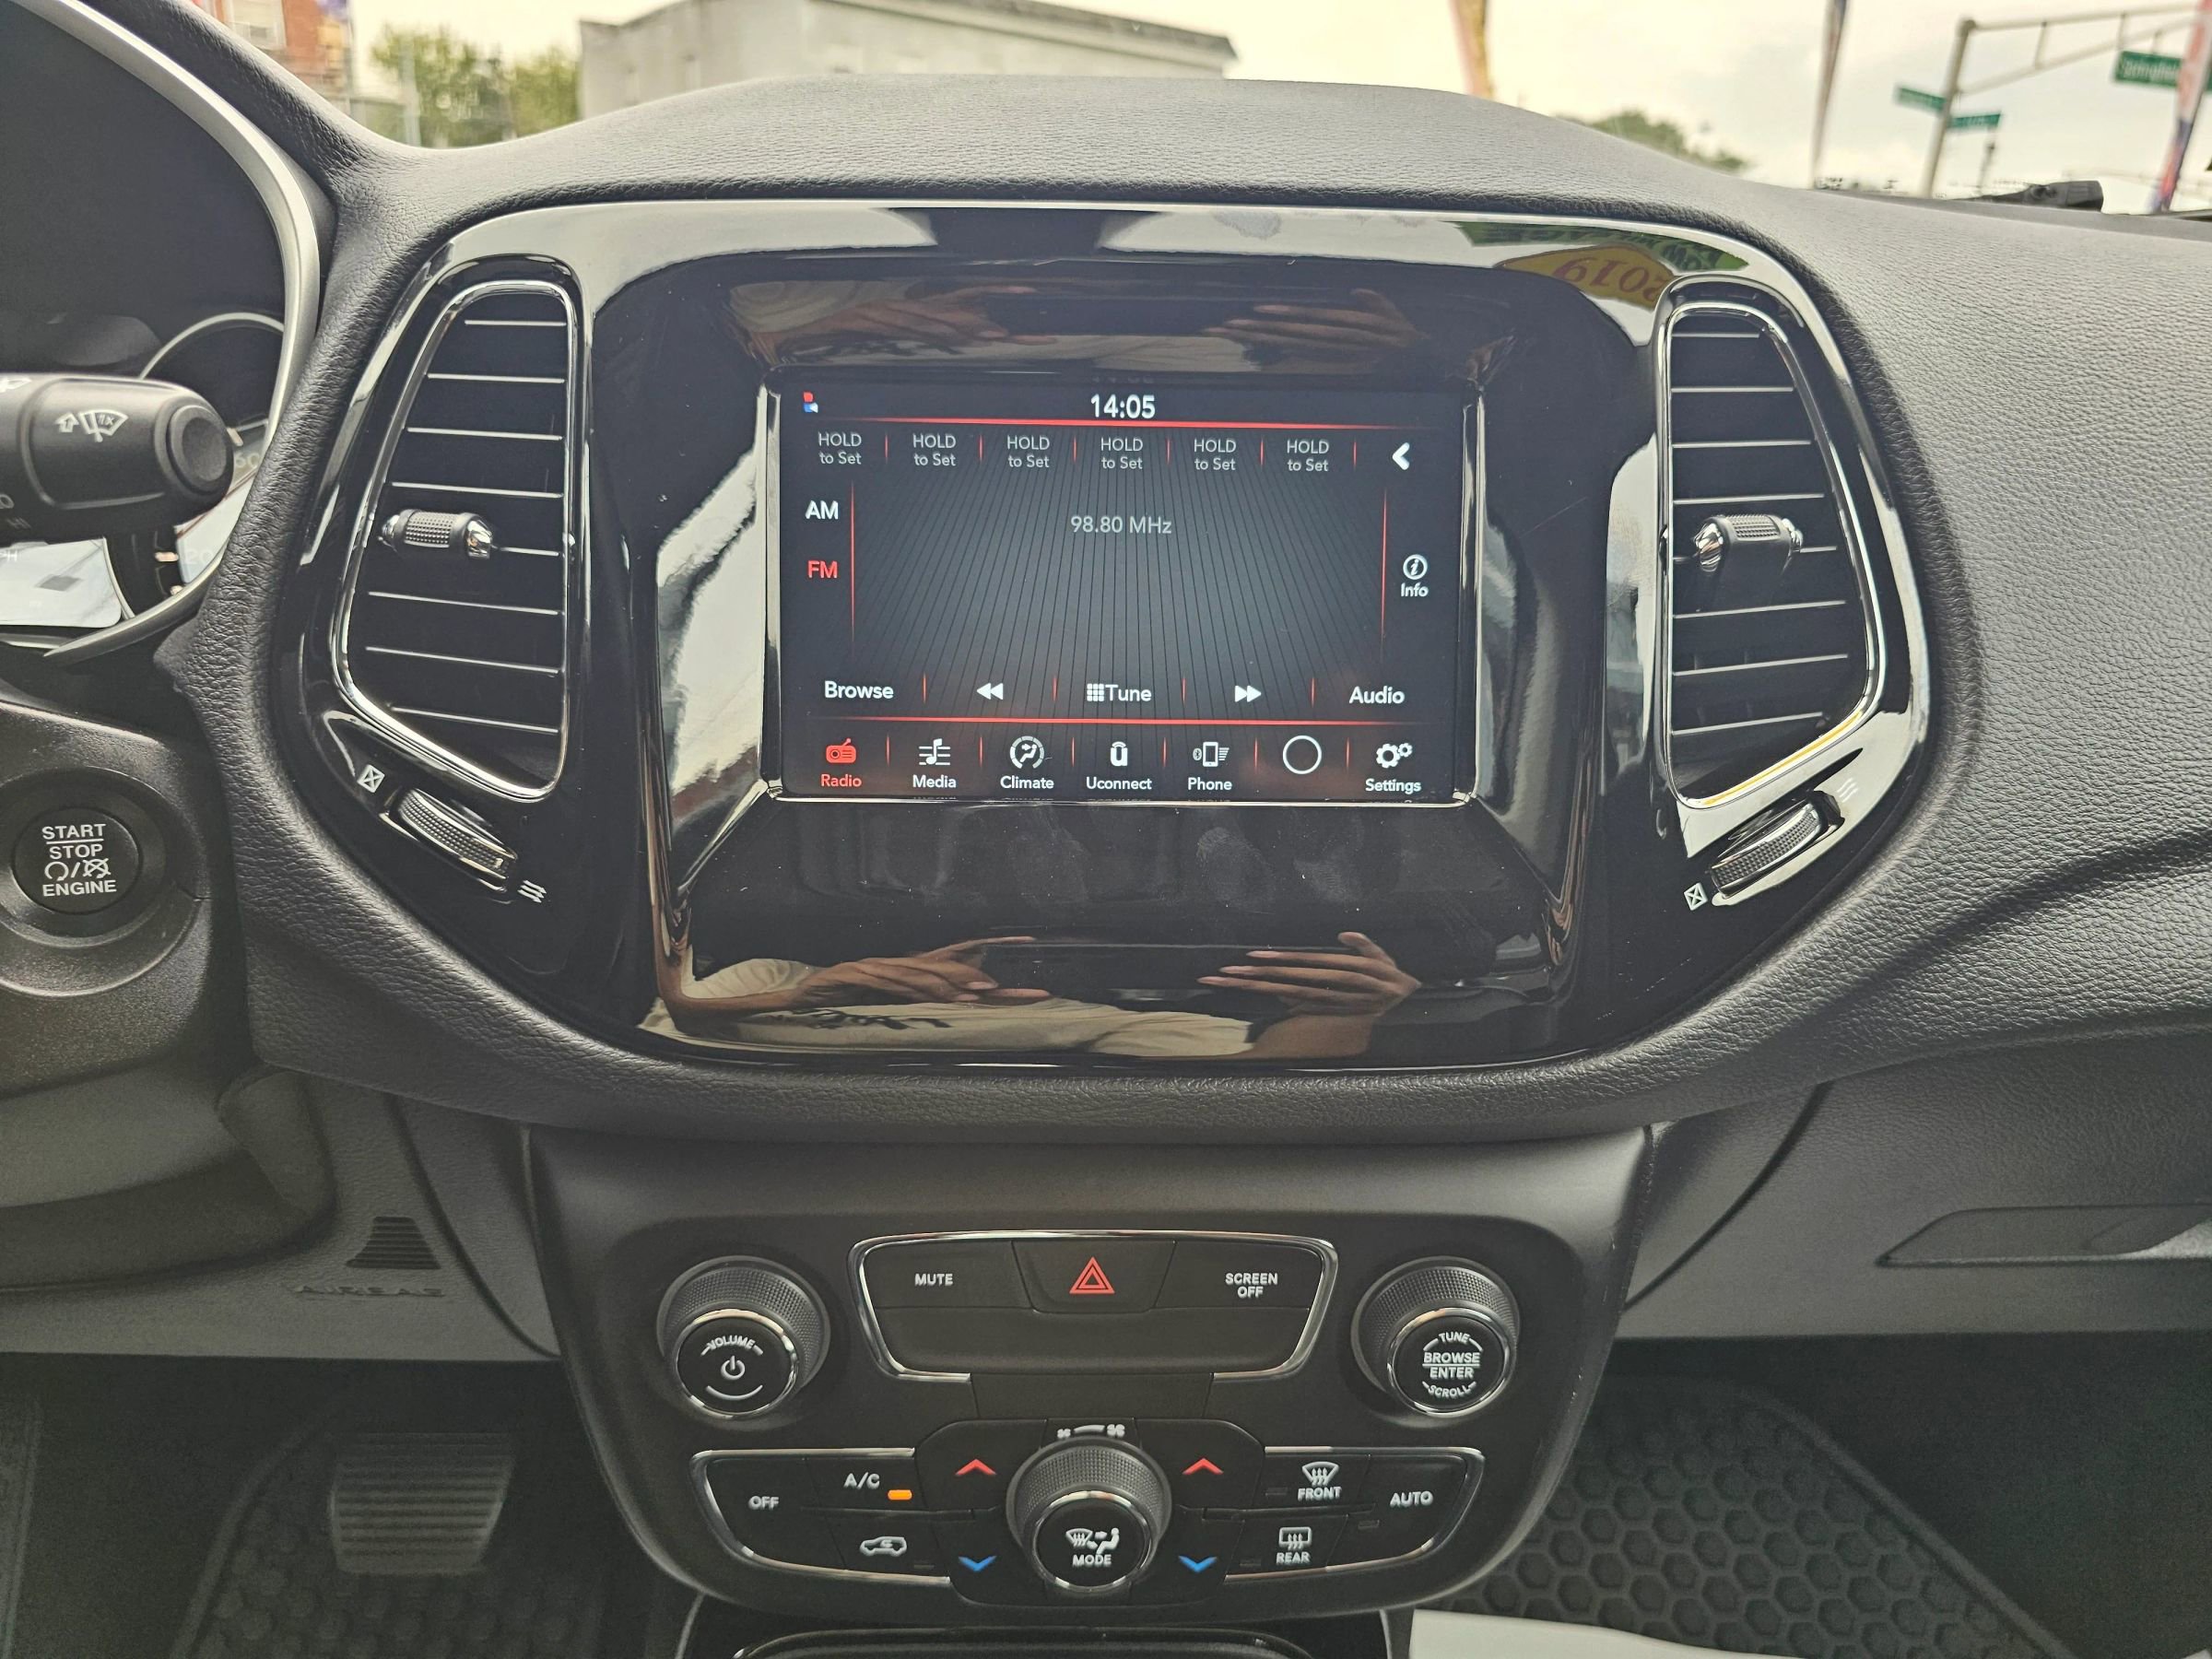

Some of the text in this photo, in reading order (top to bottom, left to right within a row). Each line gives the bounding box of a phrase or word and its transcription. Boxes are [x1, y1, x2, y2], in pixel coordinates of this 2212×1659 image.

[1089, 394, 1157, 418] 14:05
[818, 432, 862, 449] HOLD
[912, 432, 957, 449] HOLD
[1006, 434, 1051, 451] HOLD
[1100, 436, 1145, 453] HOLD
[1194, 437, 1238, 453] HOLD
[1287, 439, 1331, 455] HOLD
[819, 451, 862, 465] to Set
[913, 453, 956, 467] to Set
[1007, 454, 1050, 469] to Set
[1101, 455, 1143, 470] to Set
[1194, 457, 1236, 471] to Set
[1288, 458, 1329, 472] to Set
[805, 500, 839, 520] AM
[1070, 516, 1172, 534] 98.80 MHz
[807, 559, 838, 579] FM
[1400, 582, 1429, 598] Info
[824, 680, 894, 700] Browse
[1105, 684, 1152, 702] Tune
[1348, 686, 1406, 705] Audio
[820, 773, 862, 788] Radio
[912, 774, 957, 789] Media
[1000, 775, 1054, 790] Climate
[1086, 776, 1152, 791] Uconnect
[1187, 777, 1232, 791] Phone
[1365, 778, 1421, 795] Settings
[41, 823, 106, 840] START
[49, 843, 103, 859] STOP
[42, 879, 117, 897] ENGINE
[914, 1273, 953, 1286] MUTE
[1225, 1272, 1278, 1287] SCREEN
[1237, 1286, 1264, 1299] OFF
[706, 1335, 756, 1350] VOLUME
[1438, 1331, 1471, 1344] TUNE
[1423, 1352, 1480, 1363] BROWSE
[1430, 1367, 1475, 1380] ENTER
[1428, 1384, 1472, 1397] SCROLL
[844, 1473, 880, 1489] A/C
[1297, 1487, 1342, 1500] FRONT
[1390, 1491, 1433, 1508] AUTO
[748, 1495, 780, 1511] OFF
[1072, 1554, 1112, 1567] MODE
[1276, 1550, 1311, 1564] REAR
